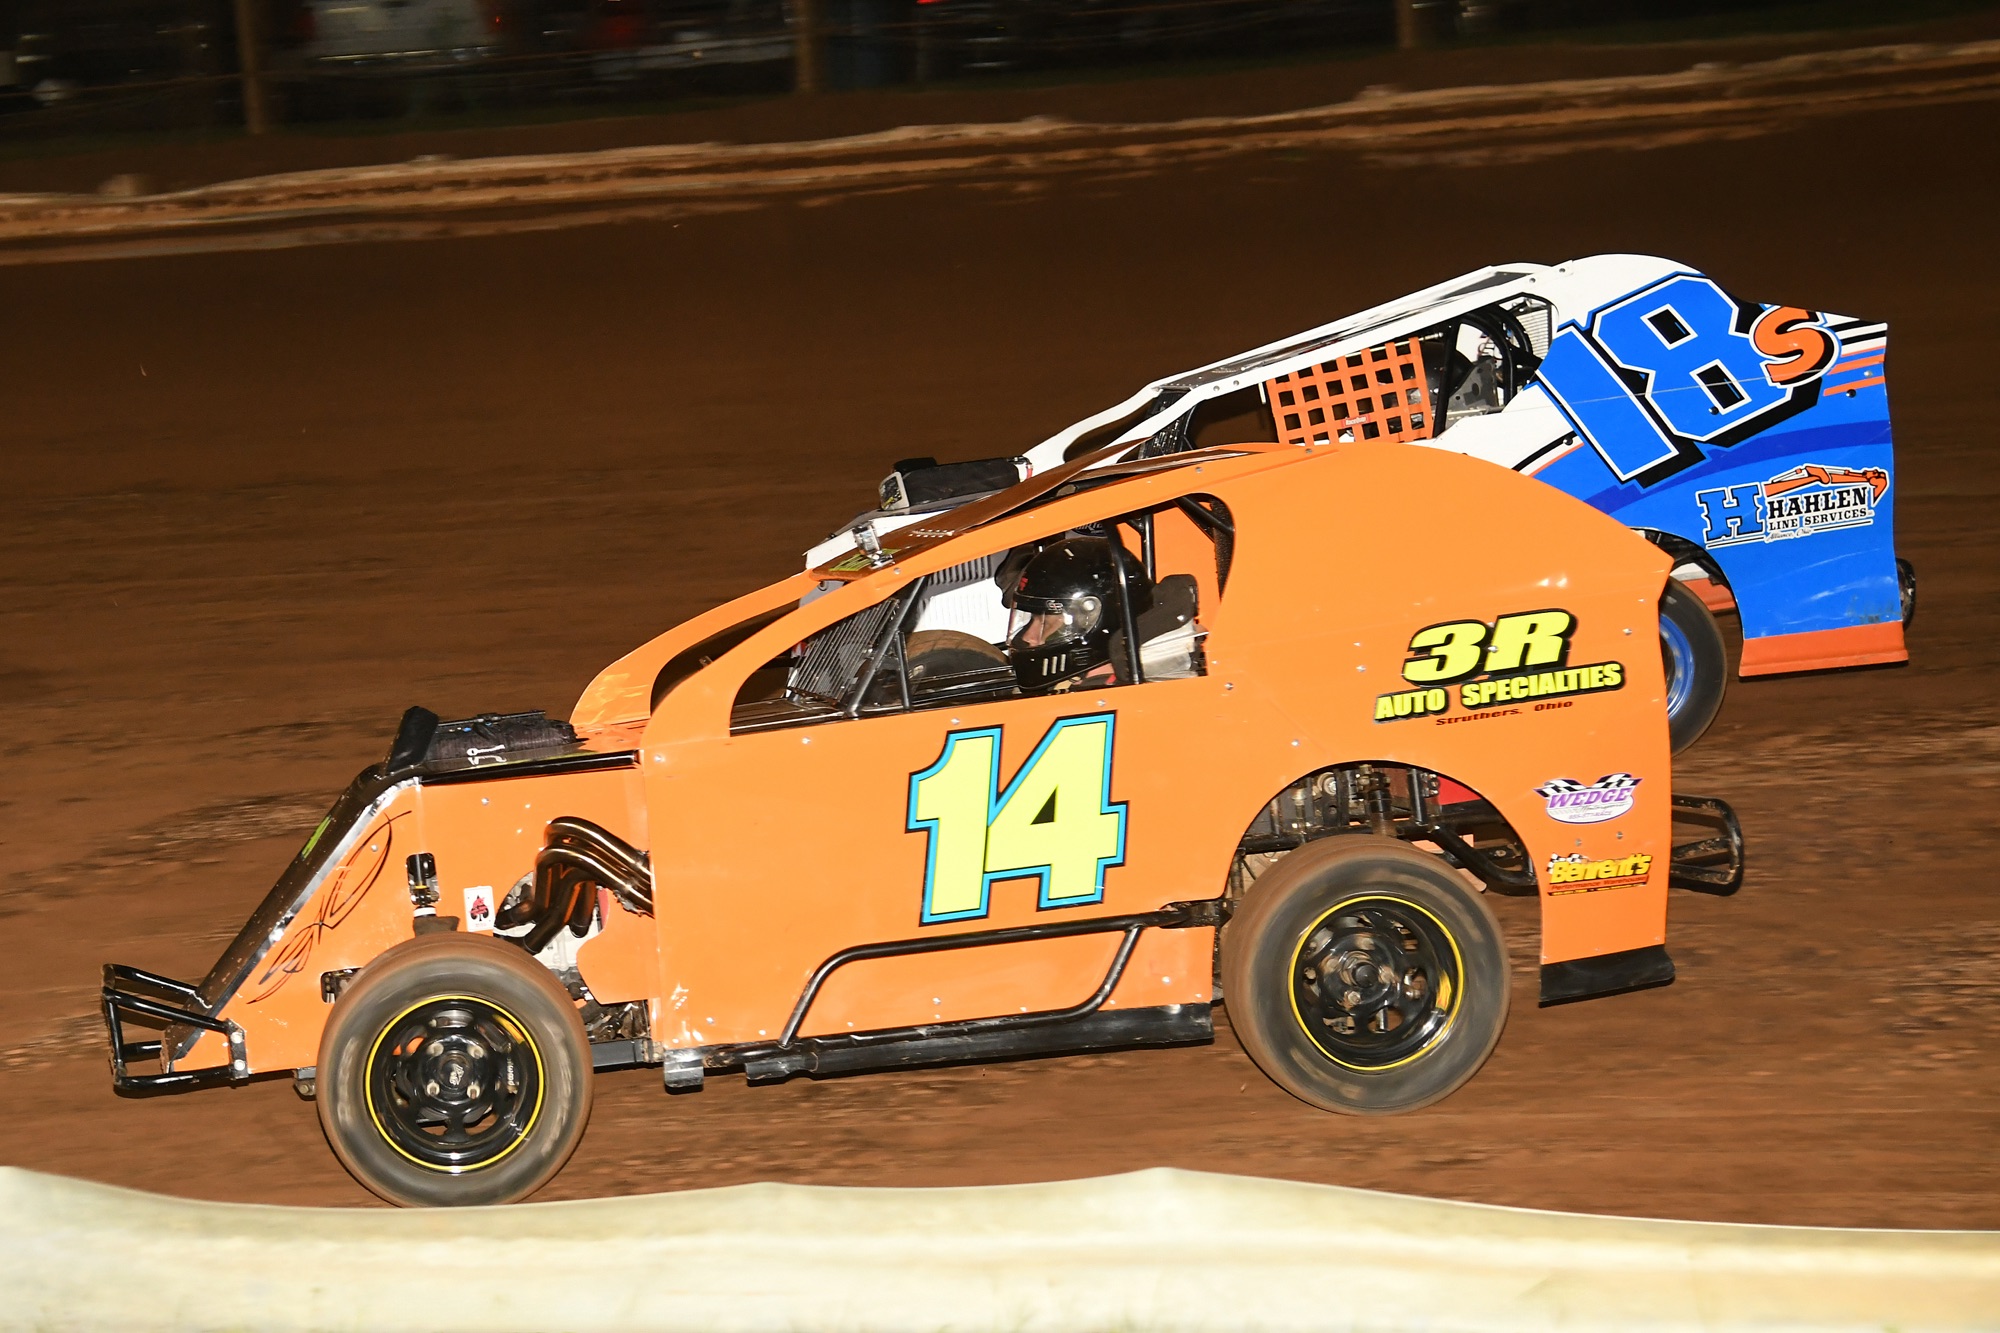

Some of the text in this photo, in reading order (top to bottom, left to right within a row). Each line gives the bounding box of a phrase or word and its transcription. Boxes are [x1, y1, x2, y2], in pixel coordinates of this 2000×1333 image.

[1767, 487, 1867, 519] HAHLEN
[1769, 508, 1867, 531] LINE SERVICES
[1403, 609, 1575, 686] 3R
[1374, 662, 1624, 721] AUTO SPECIALTIES
[1534, 701, 1573, 711] Ohio
[1549, 788, 1632, 808] WEDGE
[905, 710, 1129, 927] 14
